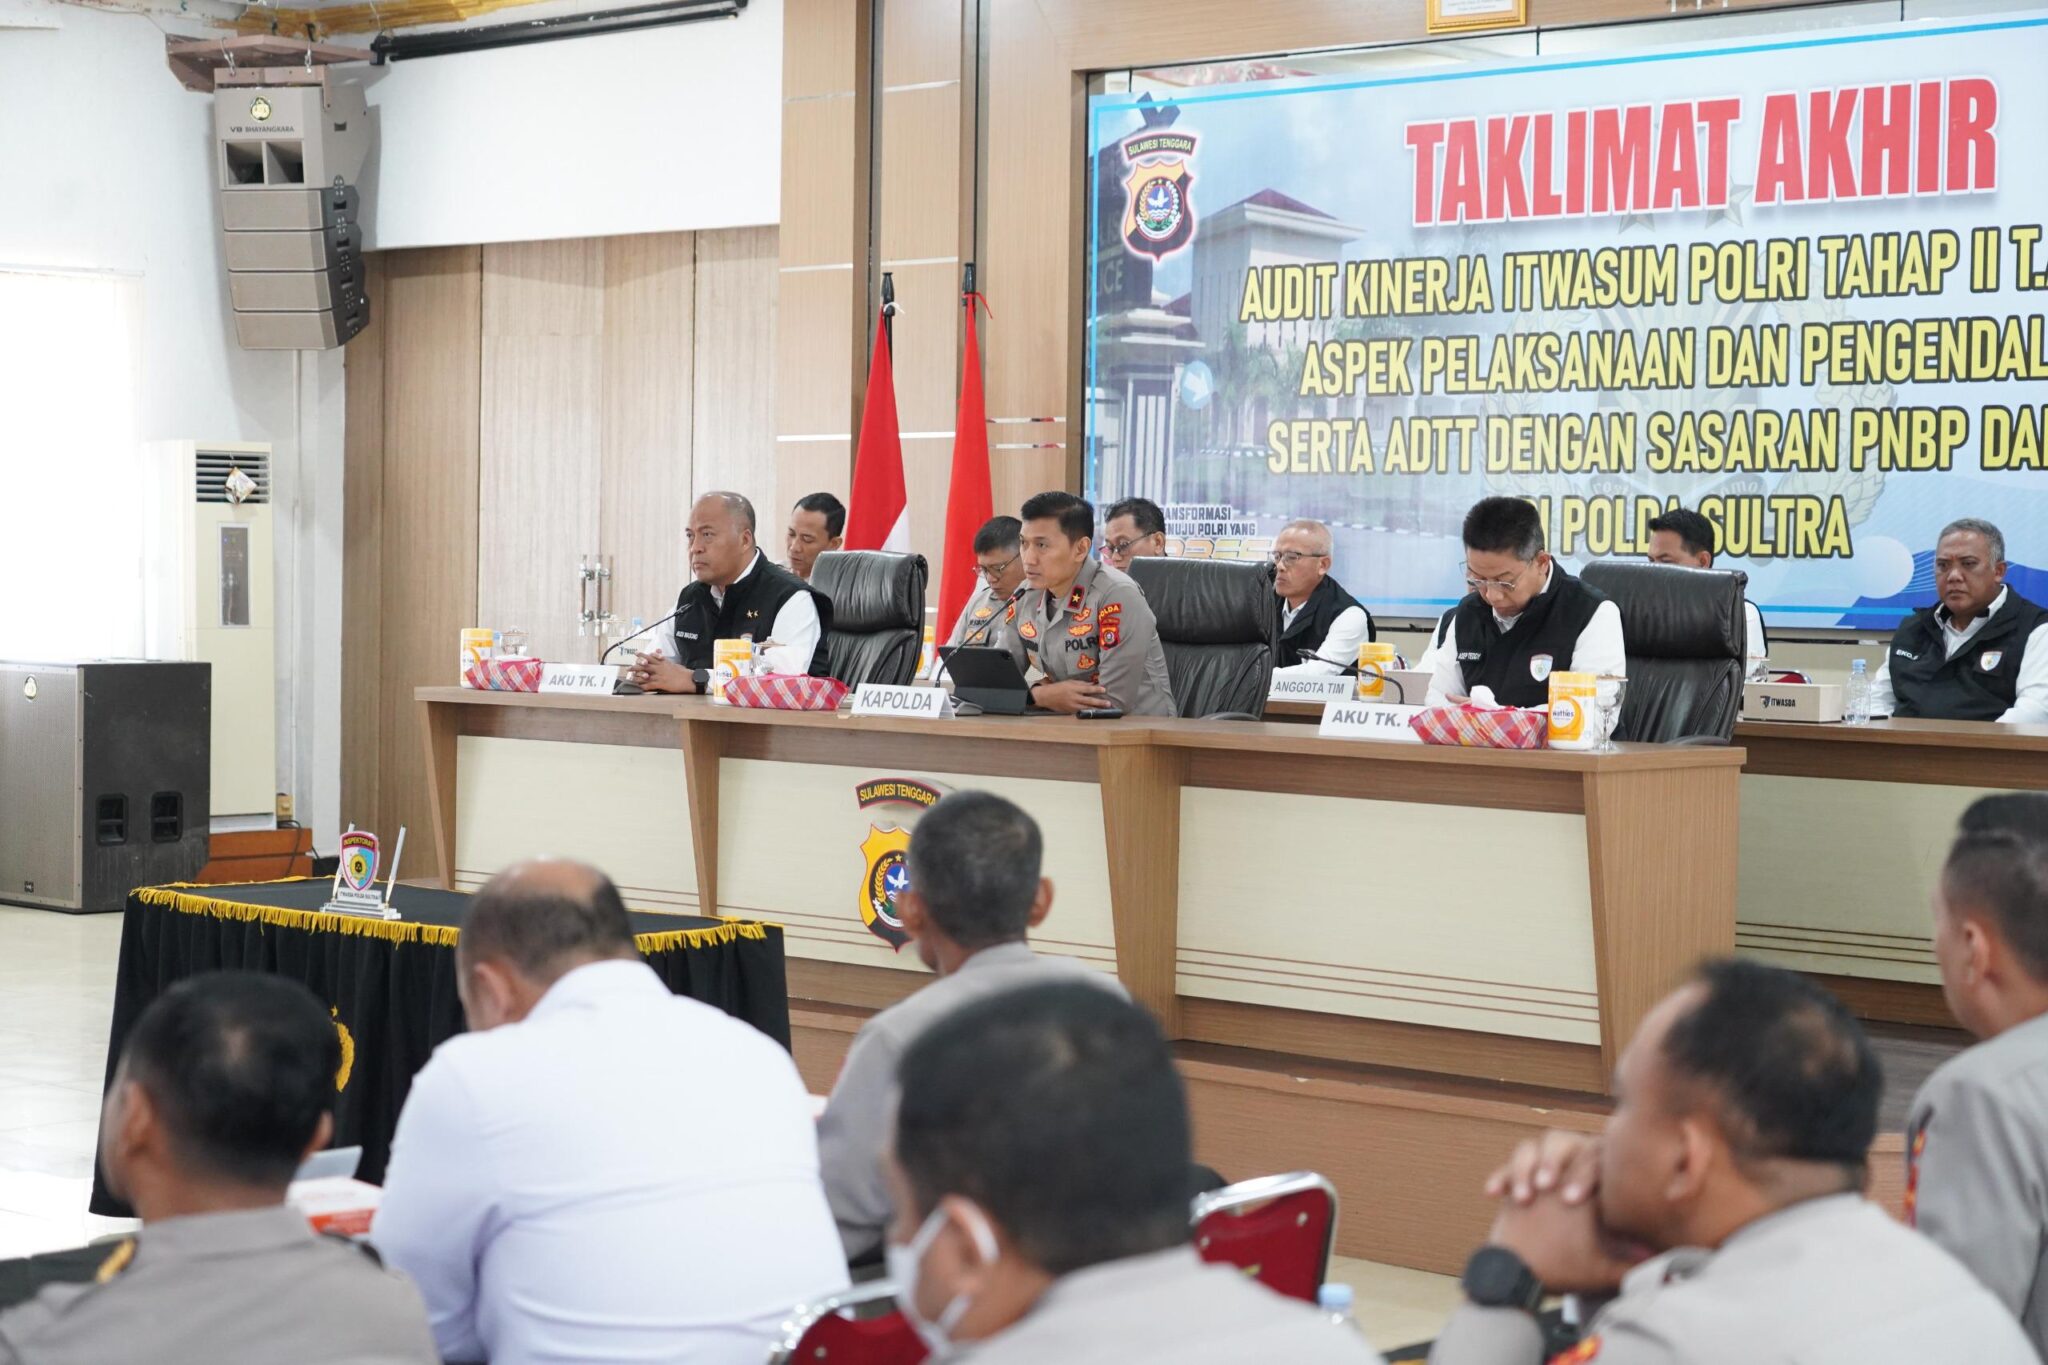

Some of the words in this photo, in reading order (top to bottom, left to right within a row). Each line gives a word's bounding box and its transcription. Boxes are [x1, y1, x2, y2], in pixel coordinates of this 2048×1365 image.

[1128, 139, 1158, 155] SULAWESI
[1159, 138, 1191, 151] TENGGARA
[1406, 98, 1740, 224] TAKLIMAT
[1755, 78, 1998, 204] AKHIR
[1240, 262, 1338, 322] AUDIT
[1345, 254, 1493, 318] KINERJA
[1503, 245, 1679, 311] ITWASUM
[1689, 238, 1809, 304] POLRI
[1818, 230, 1960, 299] TAHAP
[1970, 227, 2000, 293] II
[2009, 225, 2048, 291] T.
[1300, 337, 1413, 396] ASPEK
[1421, 327, 1696, 394] PELAKSANAAN
[1706, 324, 1790, 388] DAN
[1800, 314, 2048, 386] PENGENDAL
[1268, 417, 1374, 474] SERTA
[1383, 415, 1478, 474] ADTT
[1486, 412, 1637, 474] DENGAN
[1646, 408, 1839, 473] SASARAN
[1850, 405, 1969, 472] PNBP
[1981, 404, 2048, 472] DA
[1198, 523, 1227, 536] POLRI
[1230, 523, 1256, 536] YANG
[1699, 494, 1853, 559] SULTRA
[549, 674, 574, 686] AKU
[578, 675, 598, 687] TK.
[1275, 681, 1324, 693] ANGGOTA
[1328, 683, 1345, 694] TIM
[860, 690, 932, 711] KAPOLDA
[1332, 709, 1369, 725] AKU
[1375, 712, 1401, 727] TK.
[859, 783, 895, 802] SULAWESI
[897, 784, 937, 806] TENGGARA
